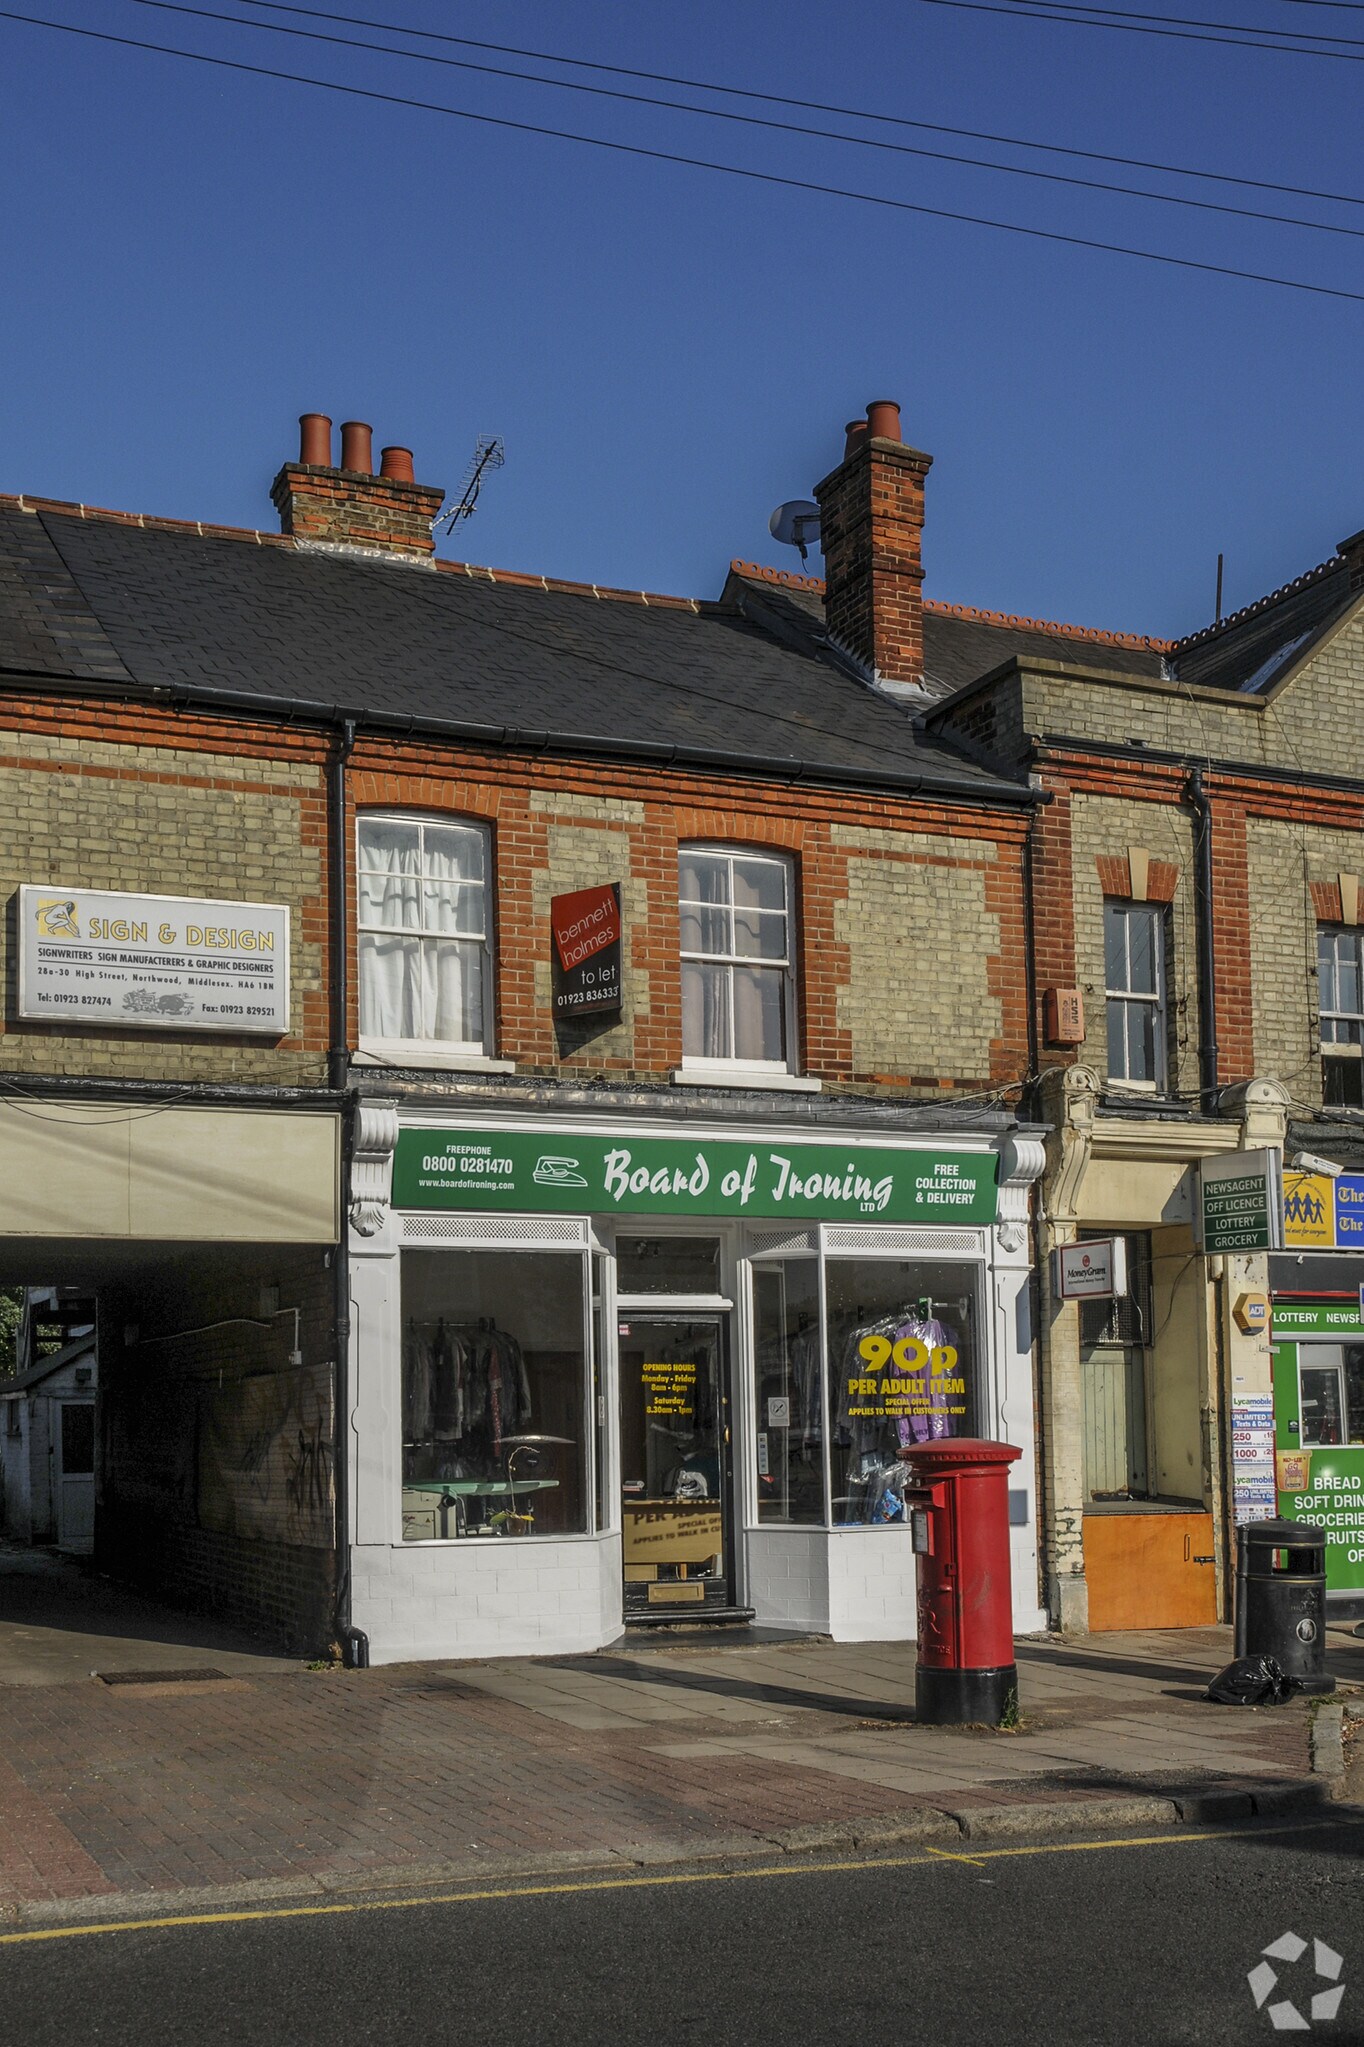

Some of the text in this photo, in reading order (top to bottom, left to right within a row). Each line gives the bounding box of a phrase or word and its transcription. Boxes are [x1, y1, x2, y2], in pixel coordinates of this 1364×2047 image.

[557, 898, 614, 944] bennett
[89, 917, 275, 952] SIGN & DESIGN
[563, 926, 614, 966] holmes
[37, 948, 93, 960] SIGNWRITERS
[97, 952, 118, 962] SIGN
[187, 959, 194, 967] &
[196, 959, 231, 970] GRAPHIC
[232, 961, 274, 973] DESIGNERS
[75, 970, 95, 979] High
[98, 971, 128, 982] Street,
[132, 974, 182, 985] Northwood,
[238, 981, 255, 989] HA6
[581, 965, 615, 985] to let
[37, 993, 112, 1006] Tel: 01923 827474
[557, 992, 584, 1006] 01923
[586, 985, 618, 1001] 836333
[202, 1004, 275, 1016] Fax: 01923 829521
[1071, 998, 1079, 1024] HSS
[446, 1145, 492, 1155] FREEPHONE
[422, 1155, 513, 1174] 0800 0281470
[934, 1164, 959, 1176] FREE
[418, 1178, 515, 1191] www.boardofironing.com
[603, 1148, 894, 1211] Board of Ironing
[915, 1177, 976, 1191] COLLECTION
[1206, 1178, 1264, 1195] NEWSAGENT
[915, 1192, 975, 1205] & DELIVERY
[1338, 1186, 1364, 1202] The
[859, 1202, 875, 1212] LTD
[1206, 1196, 1264, 1213] OFF LICENCE
[1215, 1216, 1256, 1230] LOTTERY
[1339, 1216, 1364, 1231] The
[1214, 1233, 1258, 1247] GROCERY
[1067, 1267, 1106, 1279] MoneyGram
[1249, 1305, 1265, 1315] ADT
[1273, 1312, 1318, 1323] LOTTERY
[858, 1335, 958, 1376] 90p
[642, 1363, 696, 1371] OPENING HOURS
[641, 1374, 670, 1383] Monday
[674, 1374, 696, 1384] Friday
[671, 1383, 688, 1392] 6pm
[848, 1378, 966, 1395] PER ADULT ITEM
[654, 1396, 685, 1405] Saturday
[885, 1398, 910, 1406] SPECIAL
[678, 1405, 693, 1414] 1pm
[848, 1407, 875, 1415] APPLIES
[875, 1407, 885, 1415] TO
[885, 1407, 904, 1415] WALK
[904, 1407, 912, 1415] IN
[950, 1406, 966, 1414] ONLY
[1233, 1432, 1251, 1441] 250
[1234, 1449, 1257, 1458] 1000
[1313, 1476, 1361, 1491] BREAD
[1234, 1489, 1250, 1498] 250
[1294, 1495, 1330, 1509] SOFT
